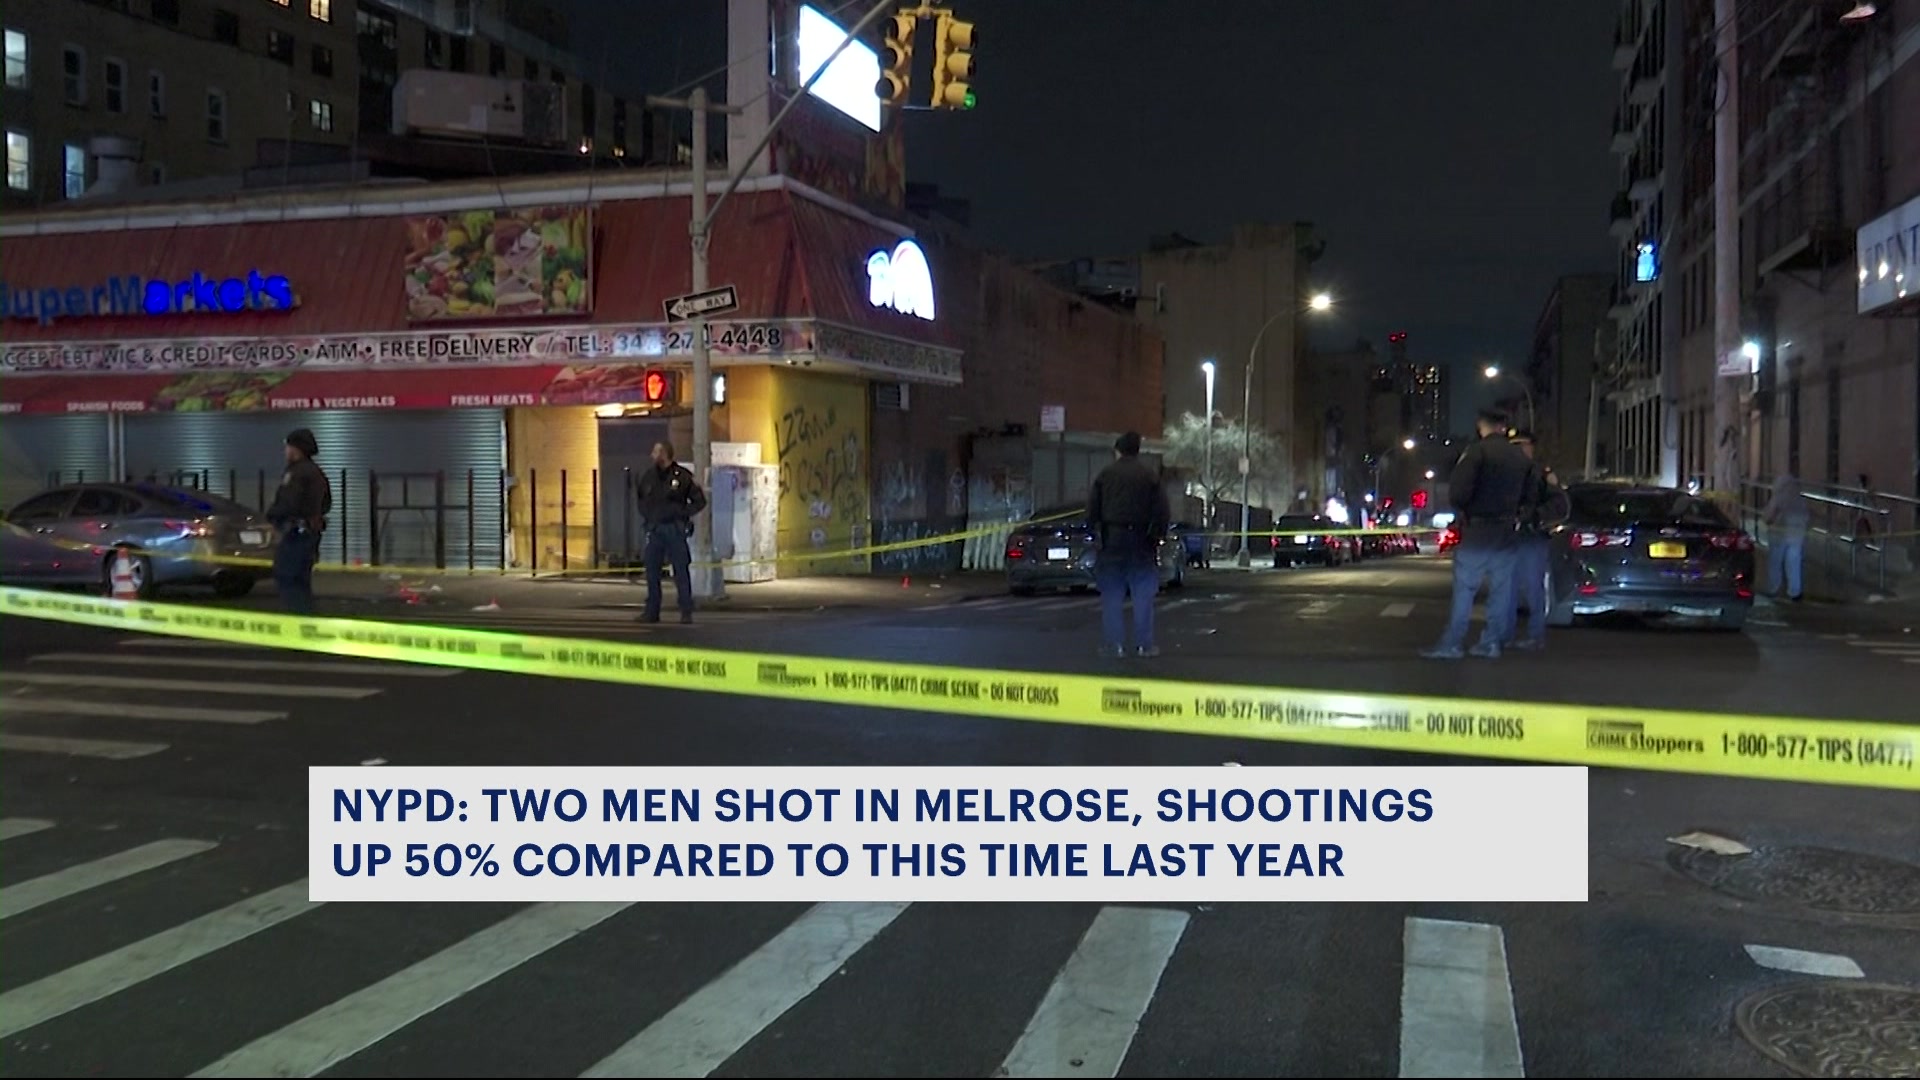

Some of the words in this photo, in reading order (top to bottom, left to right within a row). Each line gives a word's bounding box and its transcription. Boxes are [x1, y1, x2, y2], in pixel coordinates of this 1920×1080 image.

[705, 295, 726, 307] WAY
[0, 351, 58, 367] CCEPT
[63, 350, 93, 364] EBT
[104, 348, 136, 364] WIC
[143, 349, 153, 362] &
[161, 345, 225, 363] CREDIT
[232, 344, 296, 361] CARDS
[316, 343, 357, 359] ATM
[380, 340, 427, 357] FREE
[435, 337, 534, 356] DELIVERY
[565, 335, 609, 353] TEL:
[111, 401, 145, 411] FOODS
[271, 398, 310, 408] FRUITS
[323, 396, 396, 407] VEGETABLES
[451, 395, 490, 406] FRESH
[492, 394, 534, 406] MEATS
[920, 678, 948, 697] CRIME
[951, 680, 980, 699] SCENE
[991, 682, 1004, 701] DO
[1006, 683, 1024, 702] NOT
[1027, 686, 1060, 706] CROSS
[1194, 698, 1283, 724] 1-800-577-TIPS
[1427, 712, 1445, 735] DO
[1449, 714, 1474, 737] NOT
[1478, 716, 1524, 741] CROSS
[1721, 732, 1853, 764] 1-800-577-TIPS
